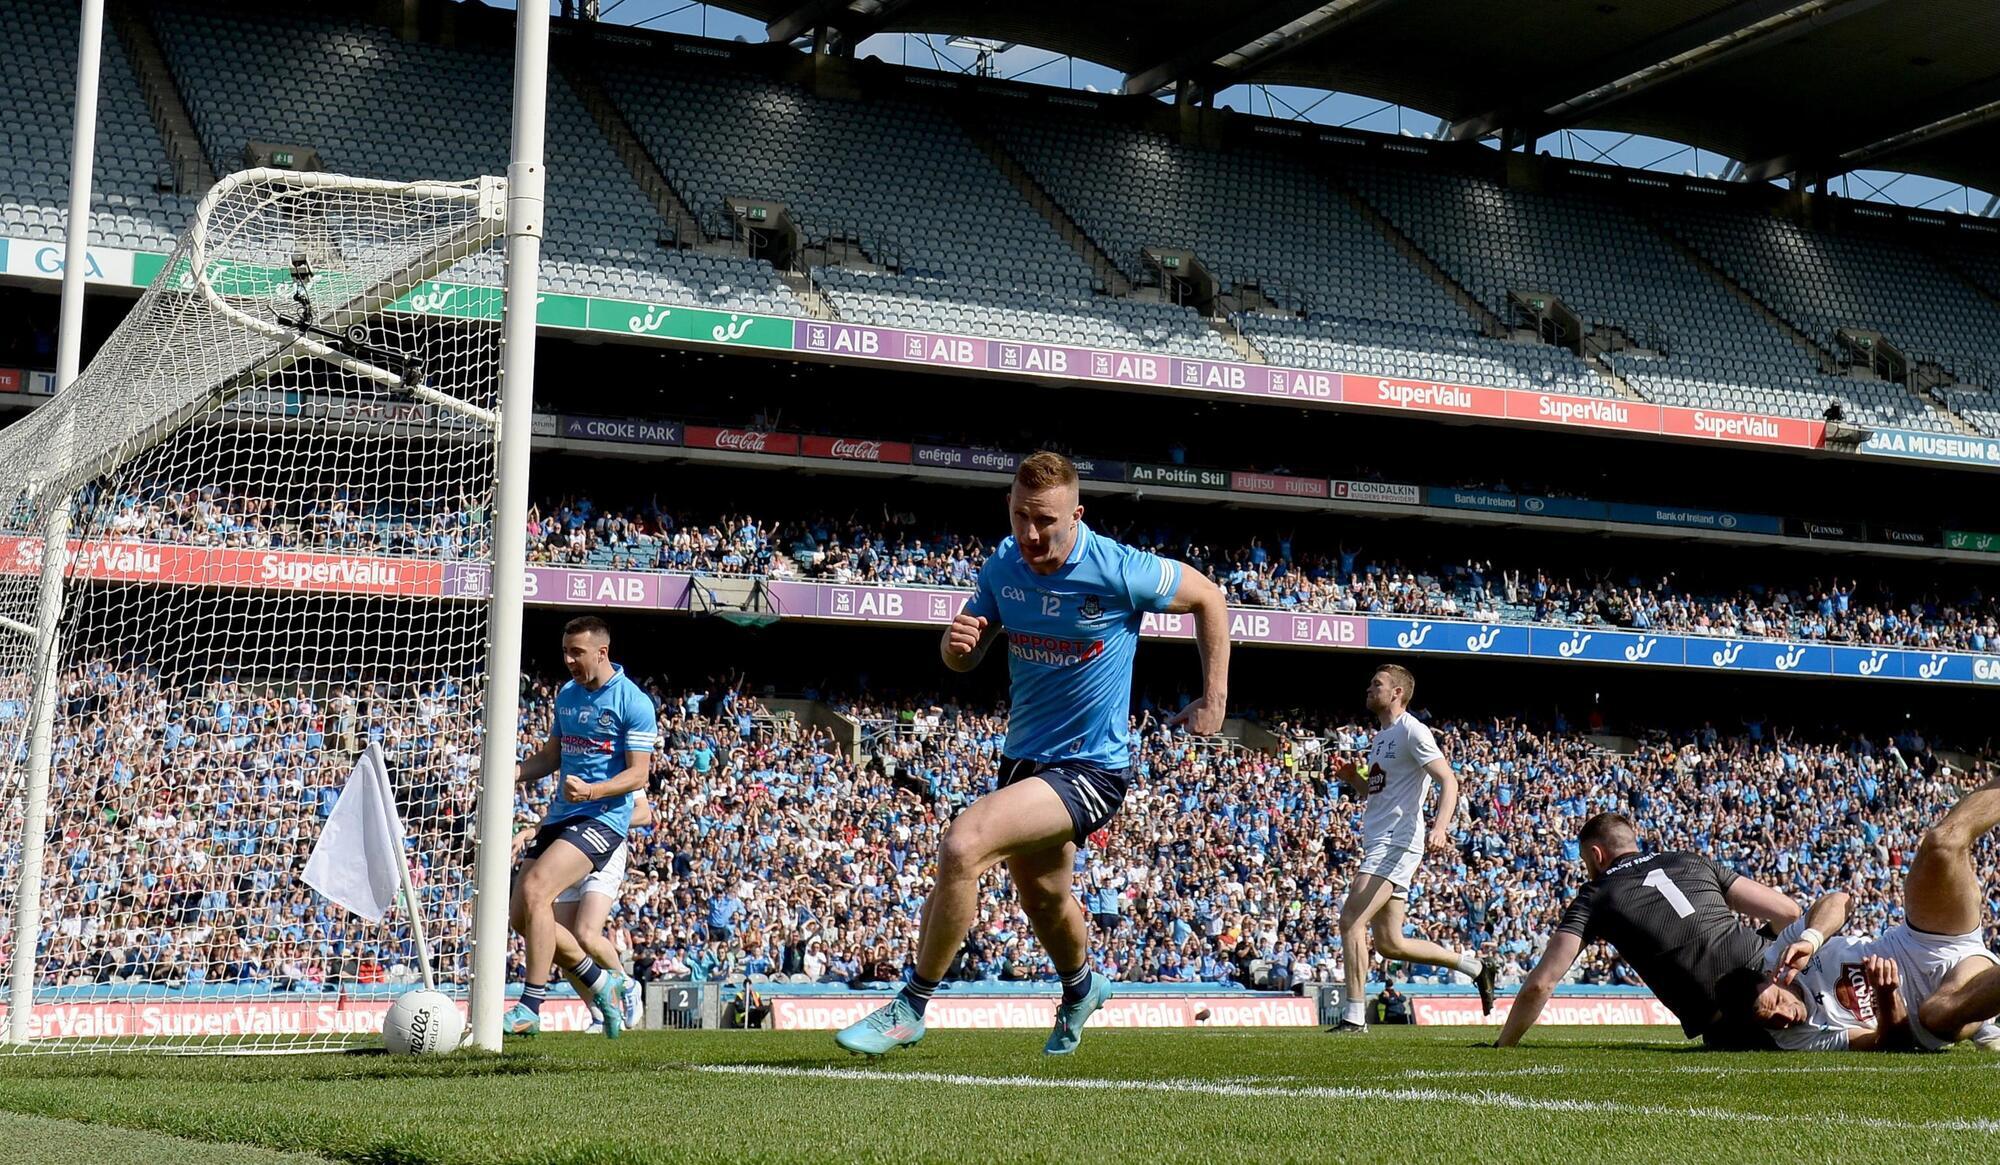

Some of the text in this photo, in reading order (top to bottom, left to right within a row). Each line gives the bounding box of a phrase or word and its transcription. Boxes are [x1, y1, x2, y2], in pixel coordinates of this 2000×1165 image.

[629, 305, 670, 332] eir
[712, 314, 753, 342] eir
[811, 330, 879, 353] AIB AIB
[908, 339, 974, 363] AIB AIB
[1004, 348, 1067, 372] AIB AIB
[1095, 357, 1157, 380] AIB AIB
[1186, 366, 1245, 389] AIB AIB
[1272, 374, 1331, 396] AIB AIB
[1378, 380, 1472, 408] SuperValu
[1539, 396, 1628, 424] SuperValu
[587, 421, 675, 441] CROKE PARK
[1694, 412, 1778, 439] SuperValu
[1867, 431, 2000, 462] GAA MUSEUM &
[1073, 460, 1095, 471] ostik
[1133, 466, 1152, 480] An
[1201, 471, 1225, 486] Stil
[1238, 476, 1322, 494] FUJITSU FUJITSU
[1350, 482, 1415, 496] CLONDALKIN
[1455, 493, 1516, 508] Bank of Ireland
[1656, 511, 1714, 525] Bank of Ireland
[16, 540, 161, 573] SerValu
[261, 554, 397, 587] SuperValu
[572, 577, 645, 602] AIB AIB
[836, 592, 904, 616] AIB AIB
[1041, 595, 1061, 617] 12
[1140, 613, 1182, 632] AIB
[1230, 615, 1270, 637] AIB
[1316, 620, 1355, 642] AIB
[1398, 621, 1431, 648] eir
[1009, 632, 1084, 654] UPPORT
[1467, 625, 1500, 651] eir
[1559, 631, 1591, 657] eir
[1625, 635, 1656, 661] eir
[1712, 641, 1743, 667] eir
[1775, 645, 1805, 670] eir
[1859, 650, 1888, 675] eir
[1919, 654, 1948, 678] eir
[1643, 868, 1695, 919] 1
[679, 990, 689, 1008] 2
[1330, 989, 1340, 1006] 3
[1849, 966, 1874, 1019] BRADY
[142, 1006, 299, 1037] SuperValu
[925, 1002, 1050, 1029] SuperValu
[1541, 1003, 1644, 1025] SuperValu
